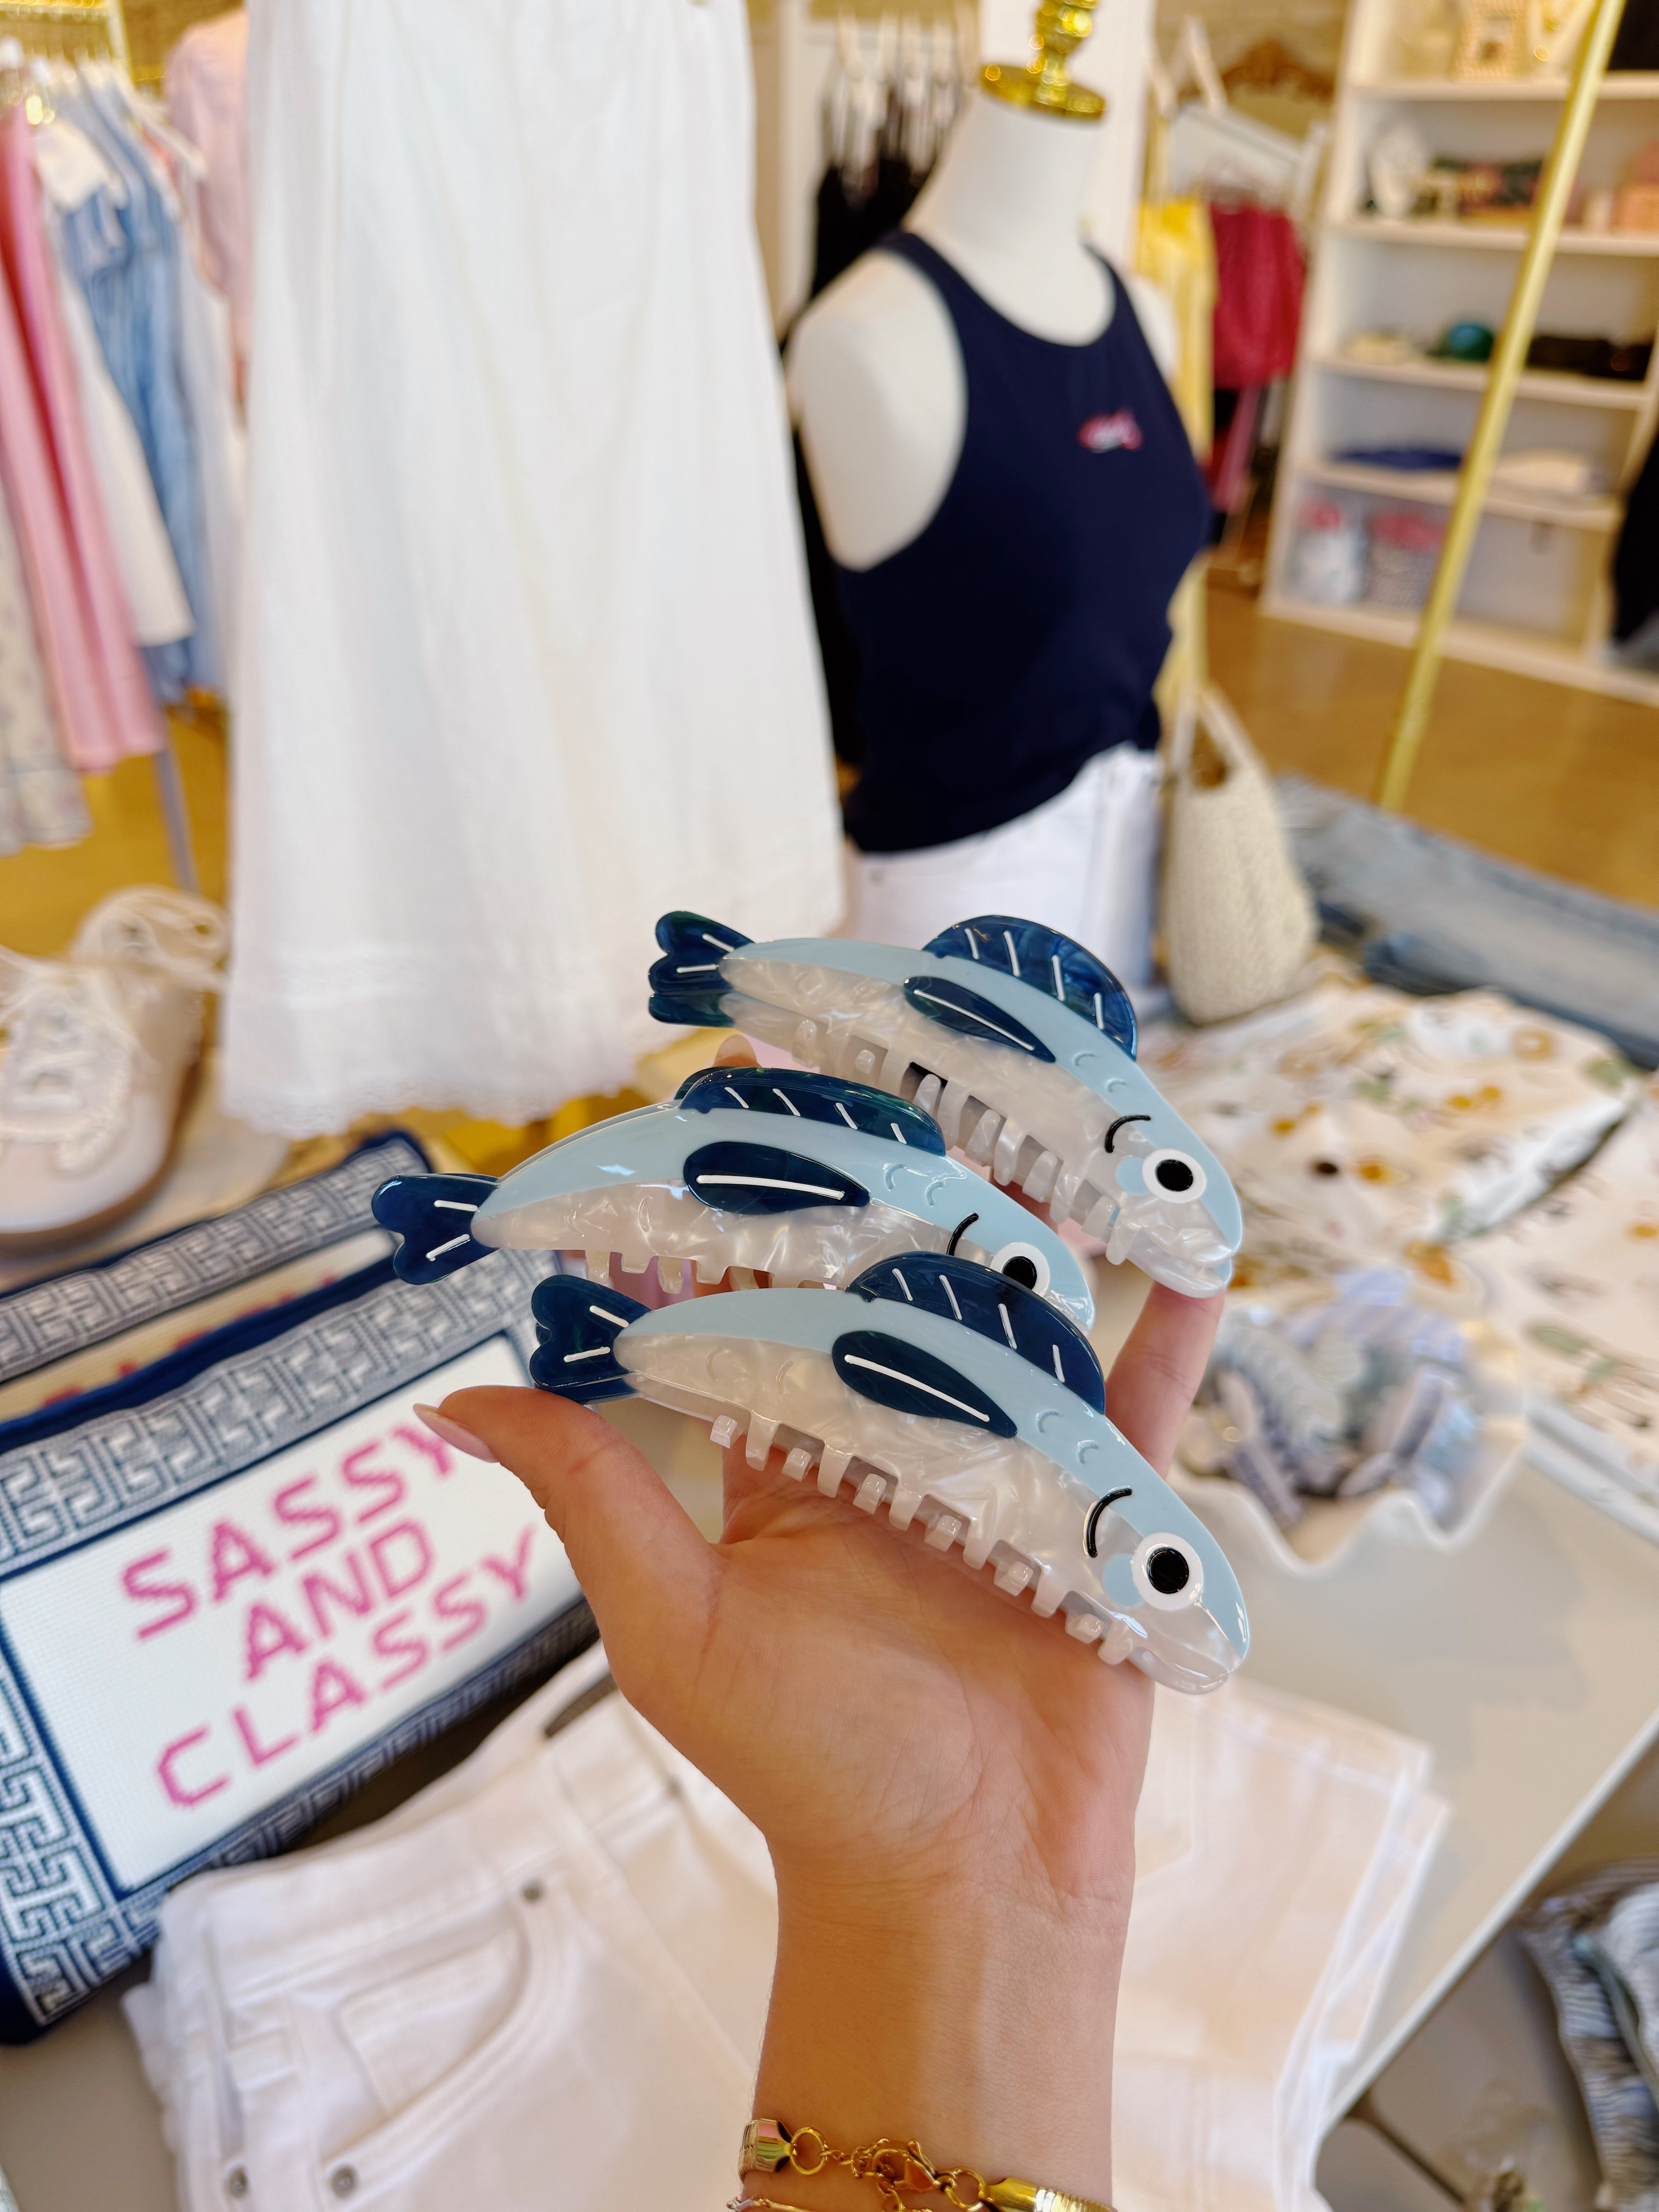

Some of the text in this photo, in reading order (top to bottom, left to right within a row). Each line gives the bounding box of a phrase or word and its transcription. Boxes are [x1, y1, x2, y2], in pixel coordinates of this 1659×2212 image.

[120, 1424, 454, 1641] SASSY
[244, 1519, 434, 1683] AND
[156, 1524, 535, 1808] CLASSY
